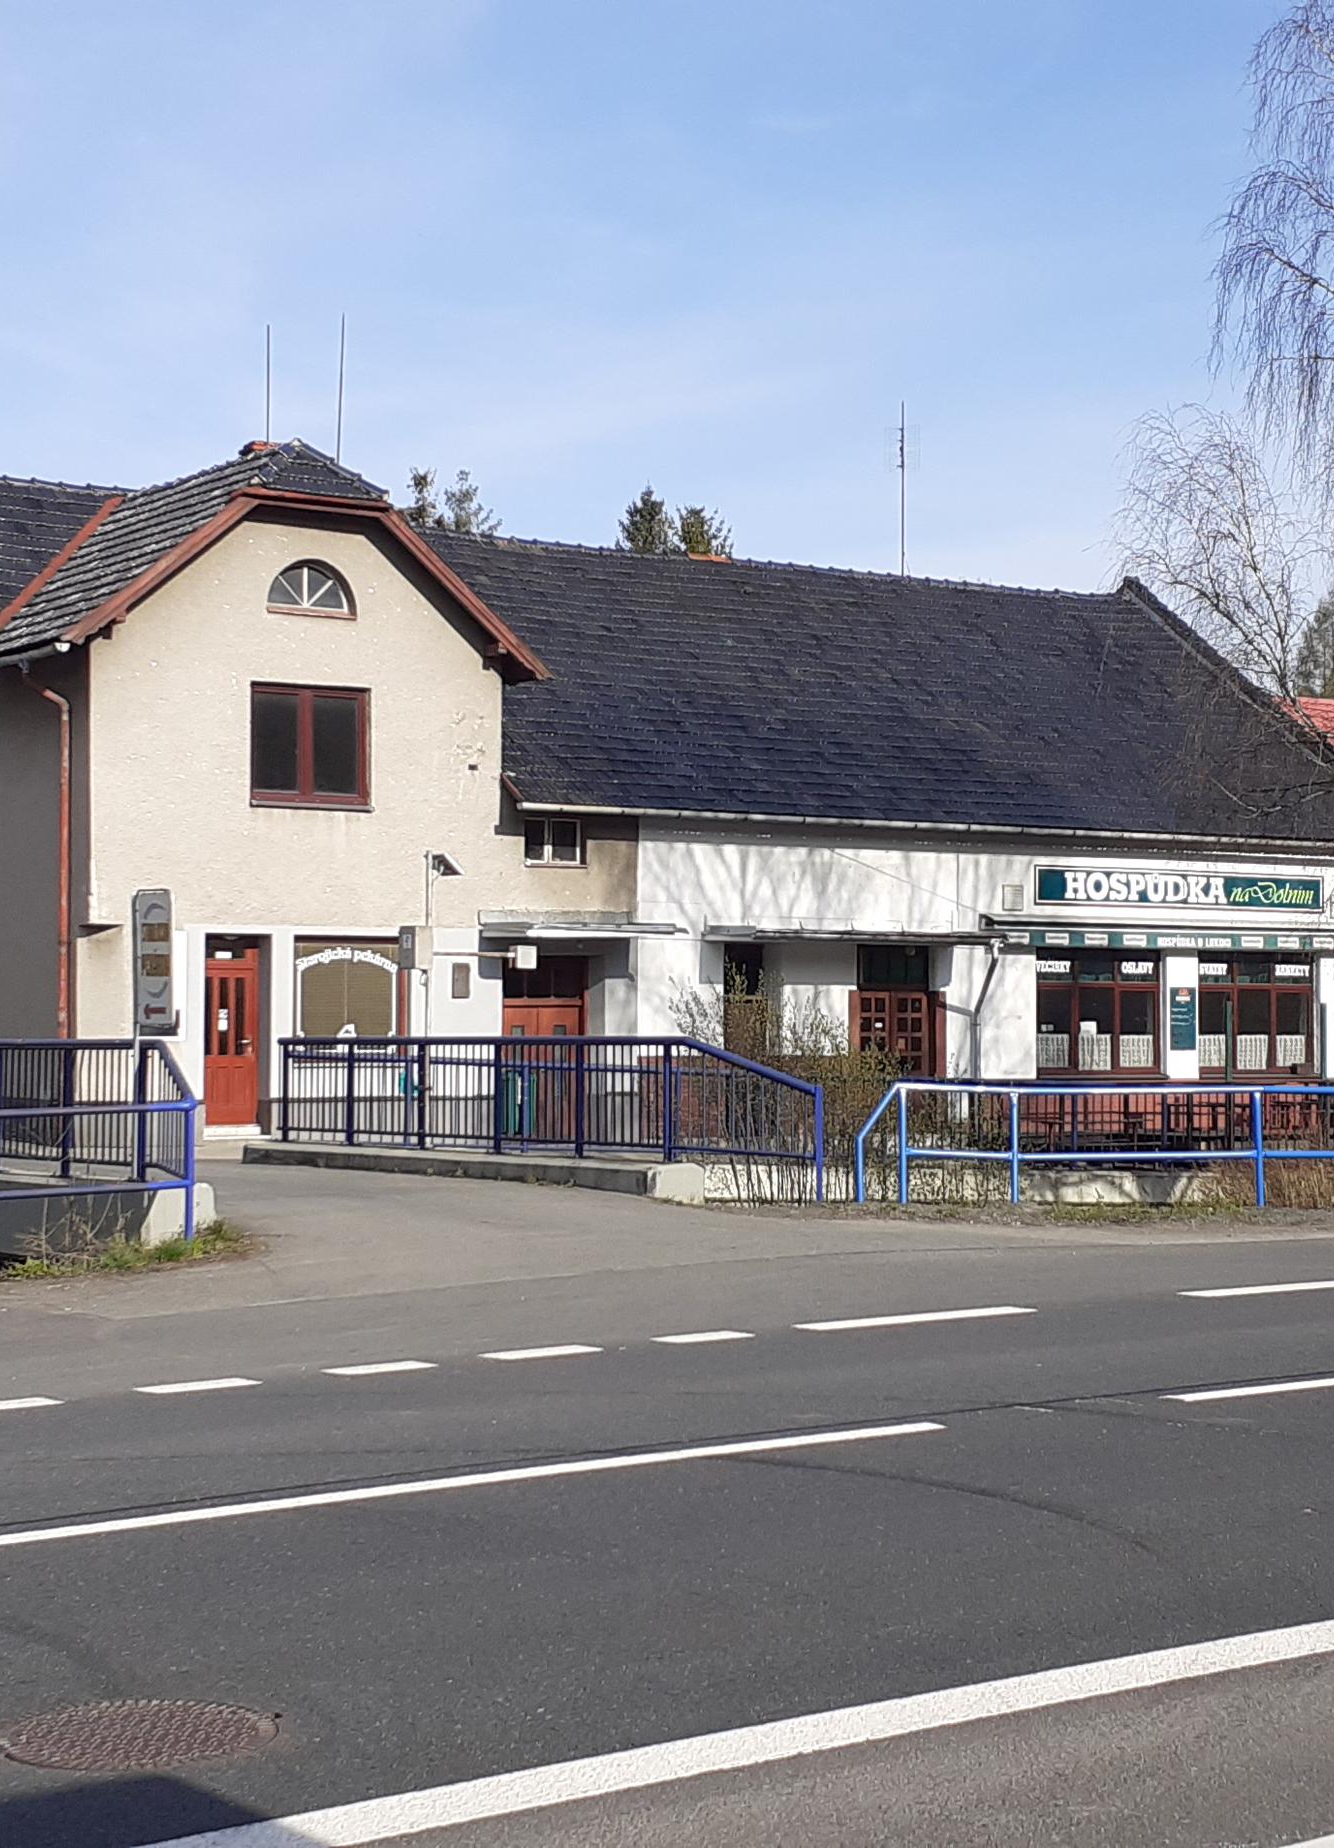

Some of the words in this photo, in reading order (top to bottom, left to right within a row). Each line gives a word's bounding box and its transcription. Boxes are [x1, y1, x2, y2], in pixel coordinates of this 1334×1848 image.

[1064, 871, 1228, 904] HOSPŮDKA
[1229, 886, 1250, 903] na
[1121, 961, 1154, 974] OSLAVY
